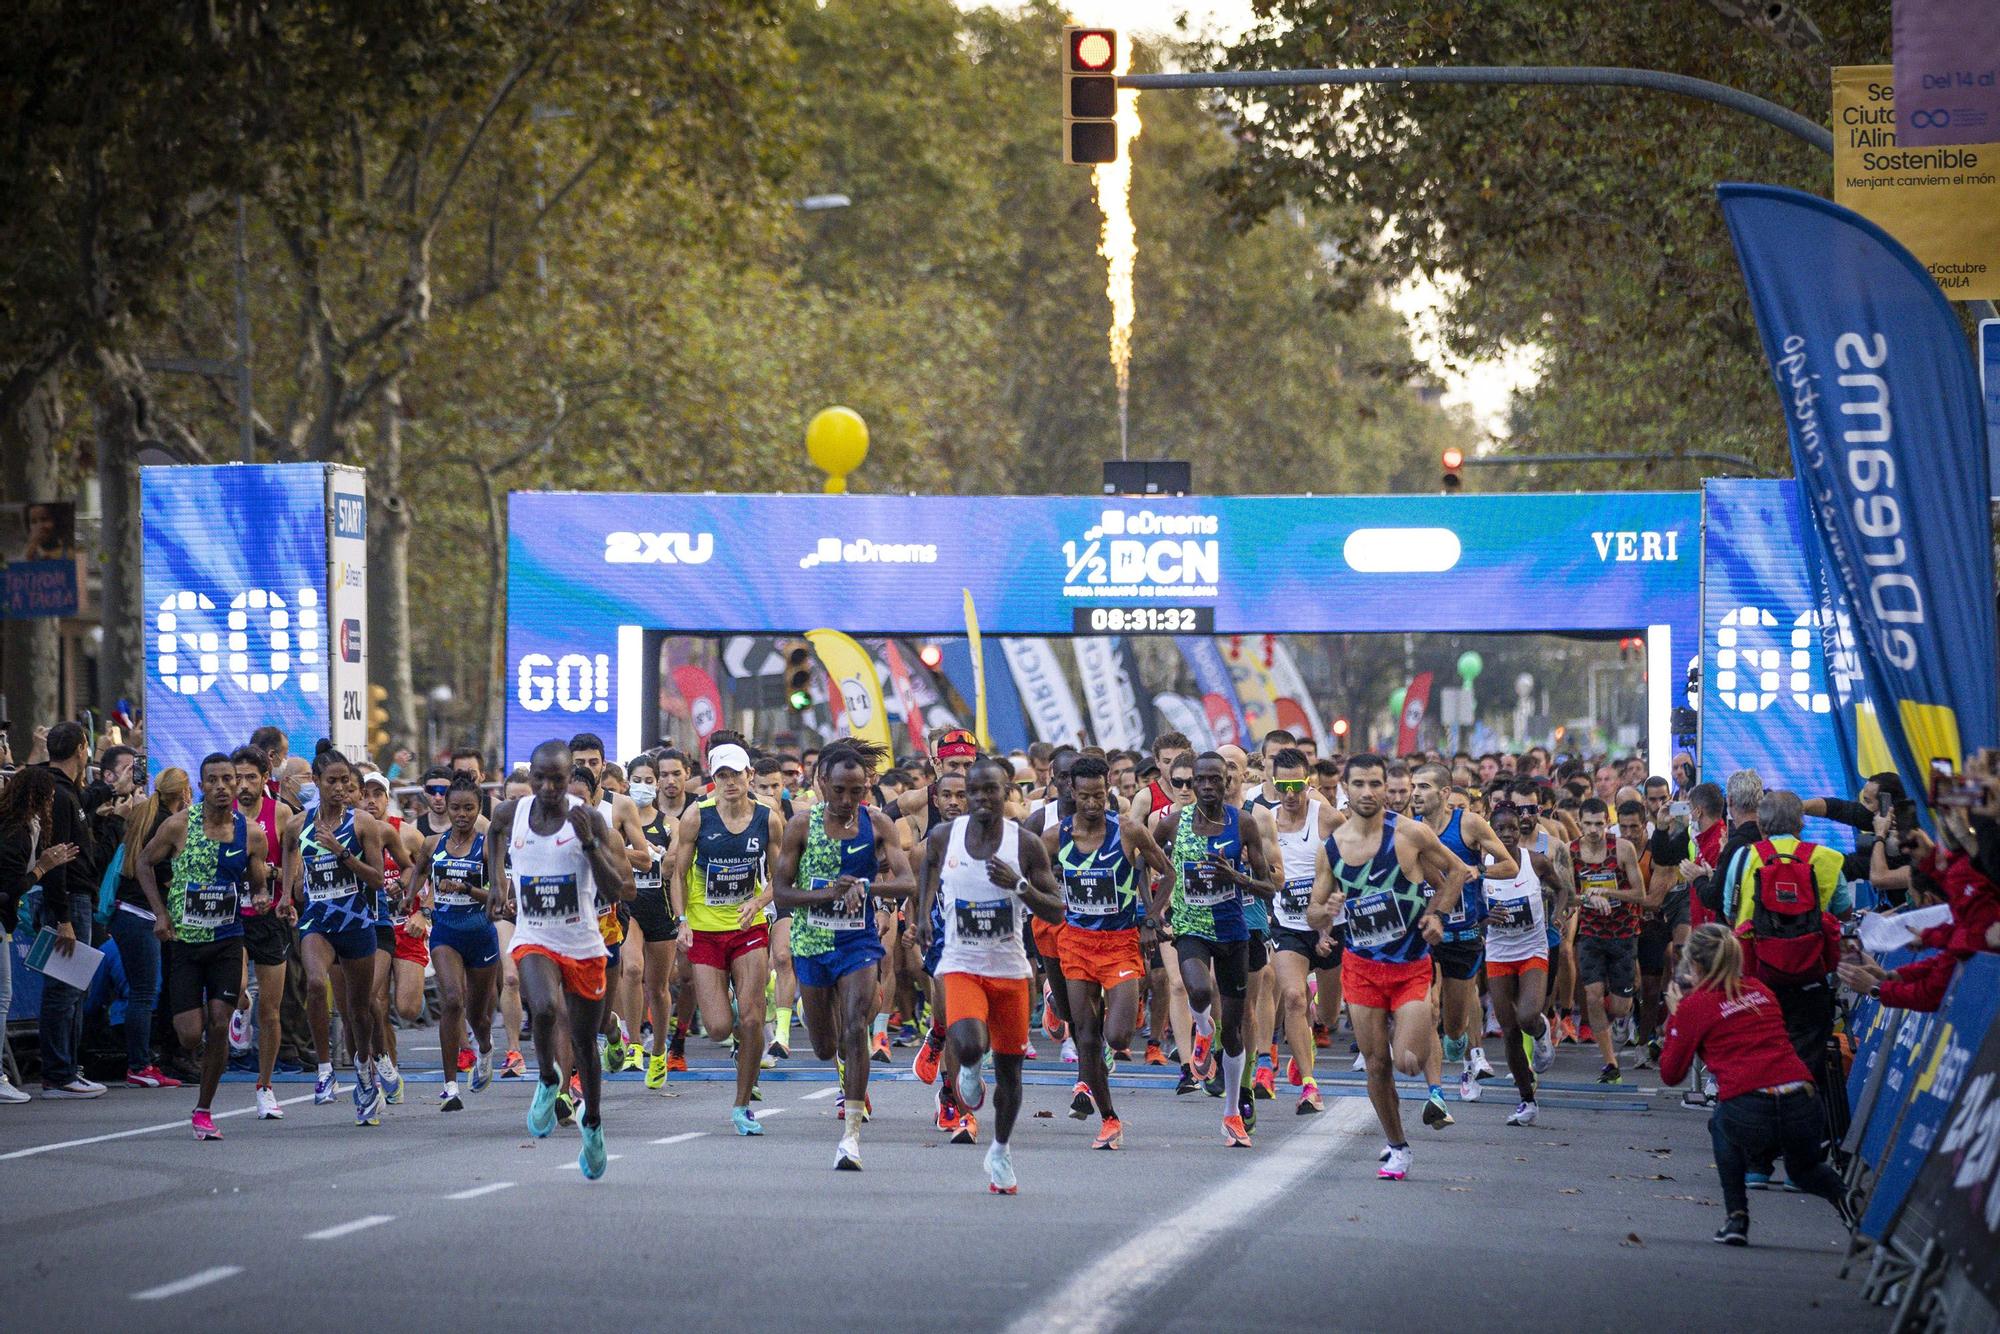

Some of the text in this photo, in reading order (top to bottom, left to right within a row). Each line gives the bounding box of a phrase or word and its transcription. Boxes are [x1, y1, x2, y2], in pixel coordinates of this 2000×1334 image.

[1922, 70, 1996, 89] Del 14 al
[1868, 83, 1895, 101] Se
[1863, 149, 1977, 171] Sostenible
[1846, 173, 1996, 190] Menjant canviem el món
[1927, 262, 1987, 275] d'octubre
[1936, 276, 1970, 288] TAULA
[338, 498, 363, 533] START
[1126, 510, 1219, 535] eDreams
[604, 531, 714, 564] 2XU
[843, 538, 937, 563] eDreams
[1591, 530, 1679, 562] VERI
[1110, 540, 1219, 584] BCN
[1091, 608, 1197, 631] 08:31:32
[157, 587, 320, 696] GO!
[517, 653, 609, 713] GO!
[746, 837, 760, 850] LS
[315, 861, 338, 871] SAMUEL
[323, 871, 333, 882] 67
[1080, 878, 1097, 886] KIFLE
[535, 885, 560, 895] PACER
[728, 881, 738, 890] 15
[1086, 886, 1093, 898] 2
[204, 900, 217, 911] 26
[541, 895, 556, 908] 29
[832, 900, 845, 911] 27
[1296, 896, 1309, 906] 22
[971, 910, 996, 919] PACER
[1353, 907, 1362, 917] EL
[977, 920, 992, 931] 28
[1368, 915, 1376, 926] 7
